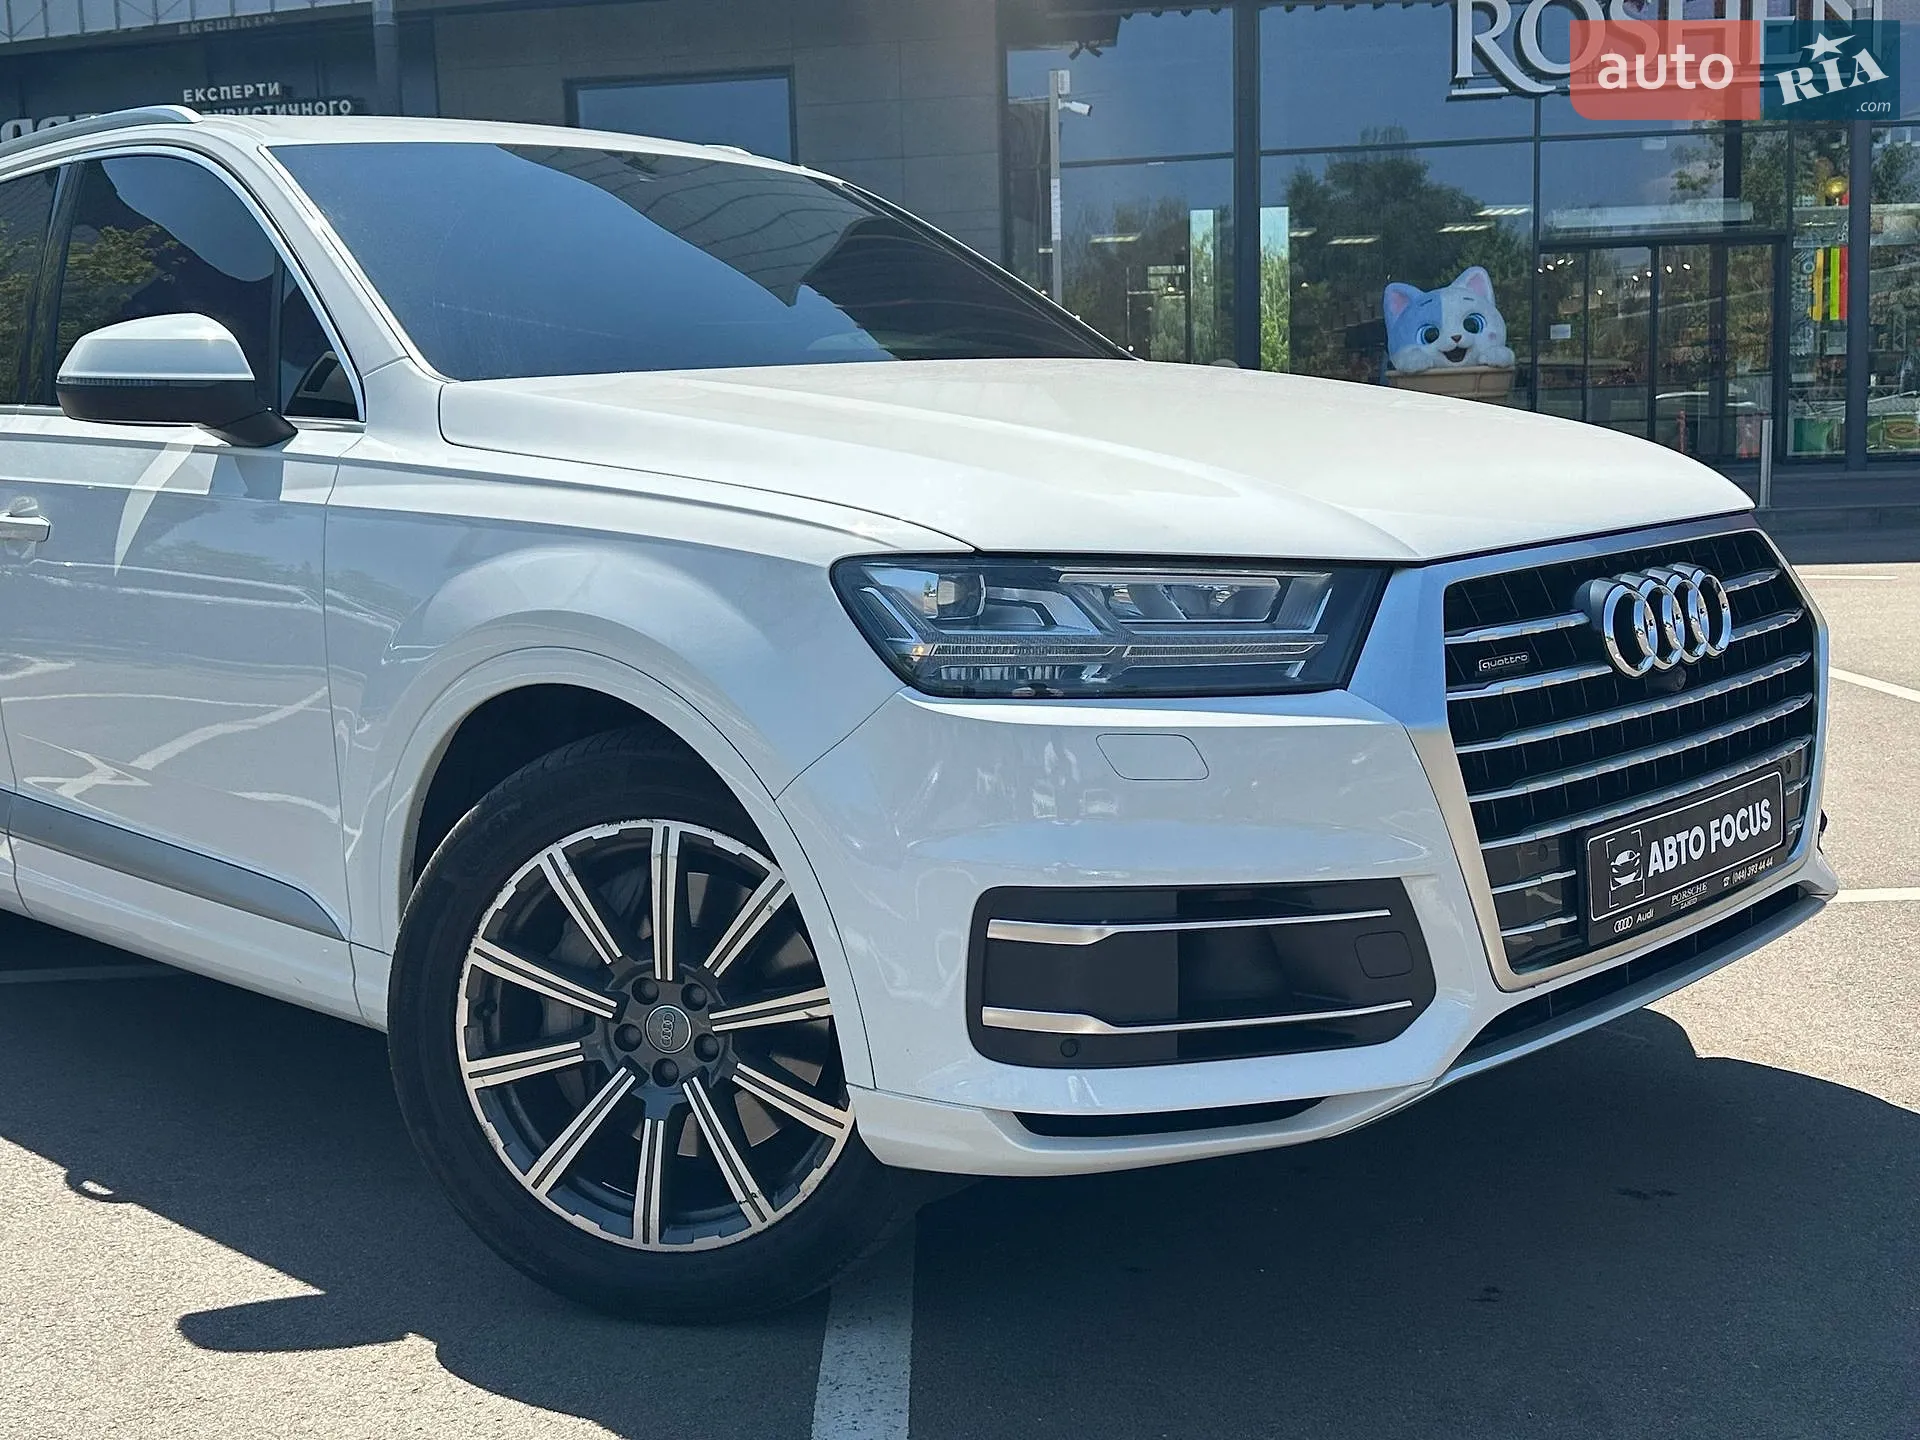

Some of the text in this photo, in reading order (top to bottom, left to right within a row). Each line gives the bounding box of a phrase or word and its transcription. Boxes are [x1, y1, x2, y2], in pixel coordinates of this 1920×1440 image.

[1455, 0, 1884, 93] ROSHEN
[183, 82, 280, 102] ЕКСПЕРТИ
[1482, 654, 1528, 669] quattro
[1709, 798, 1772, 854] FOCUS
[1671, 882, 1708, 905] PORSCHE
[1636, 908, 1655, 923] Audi
